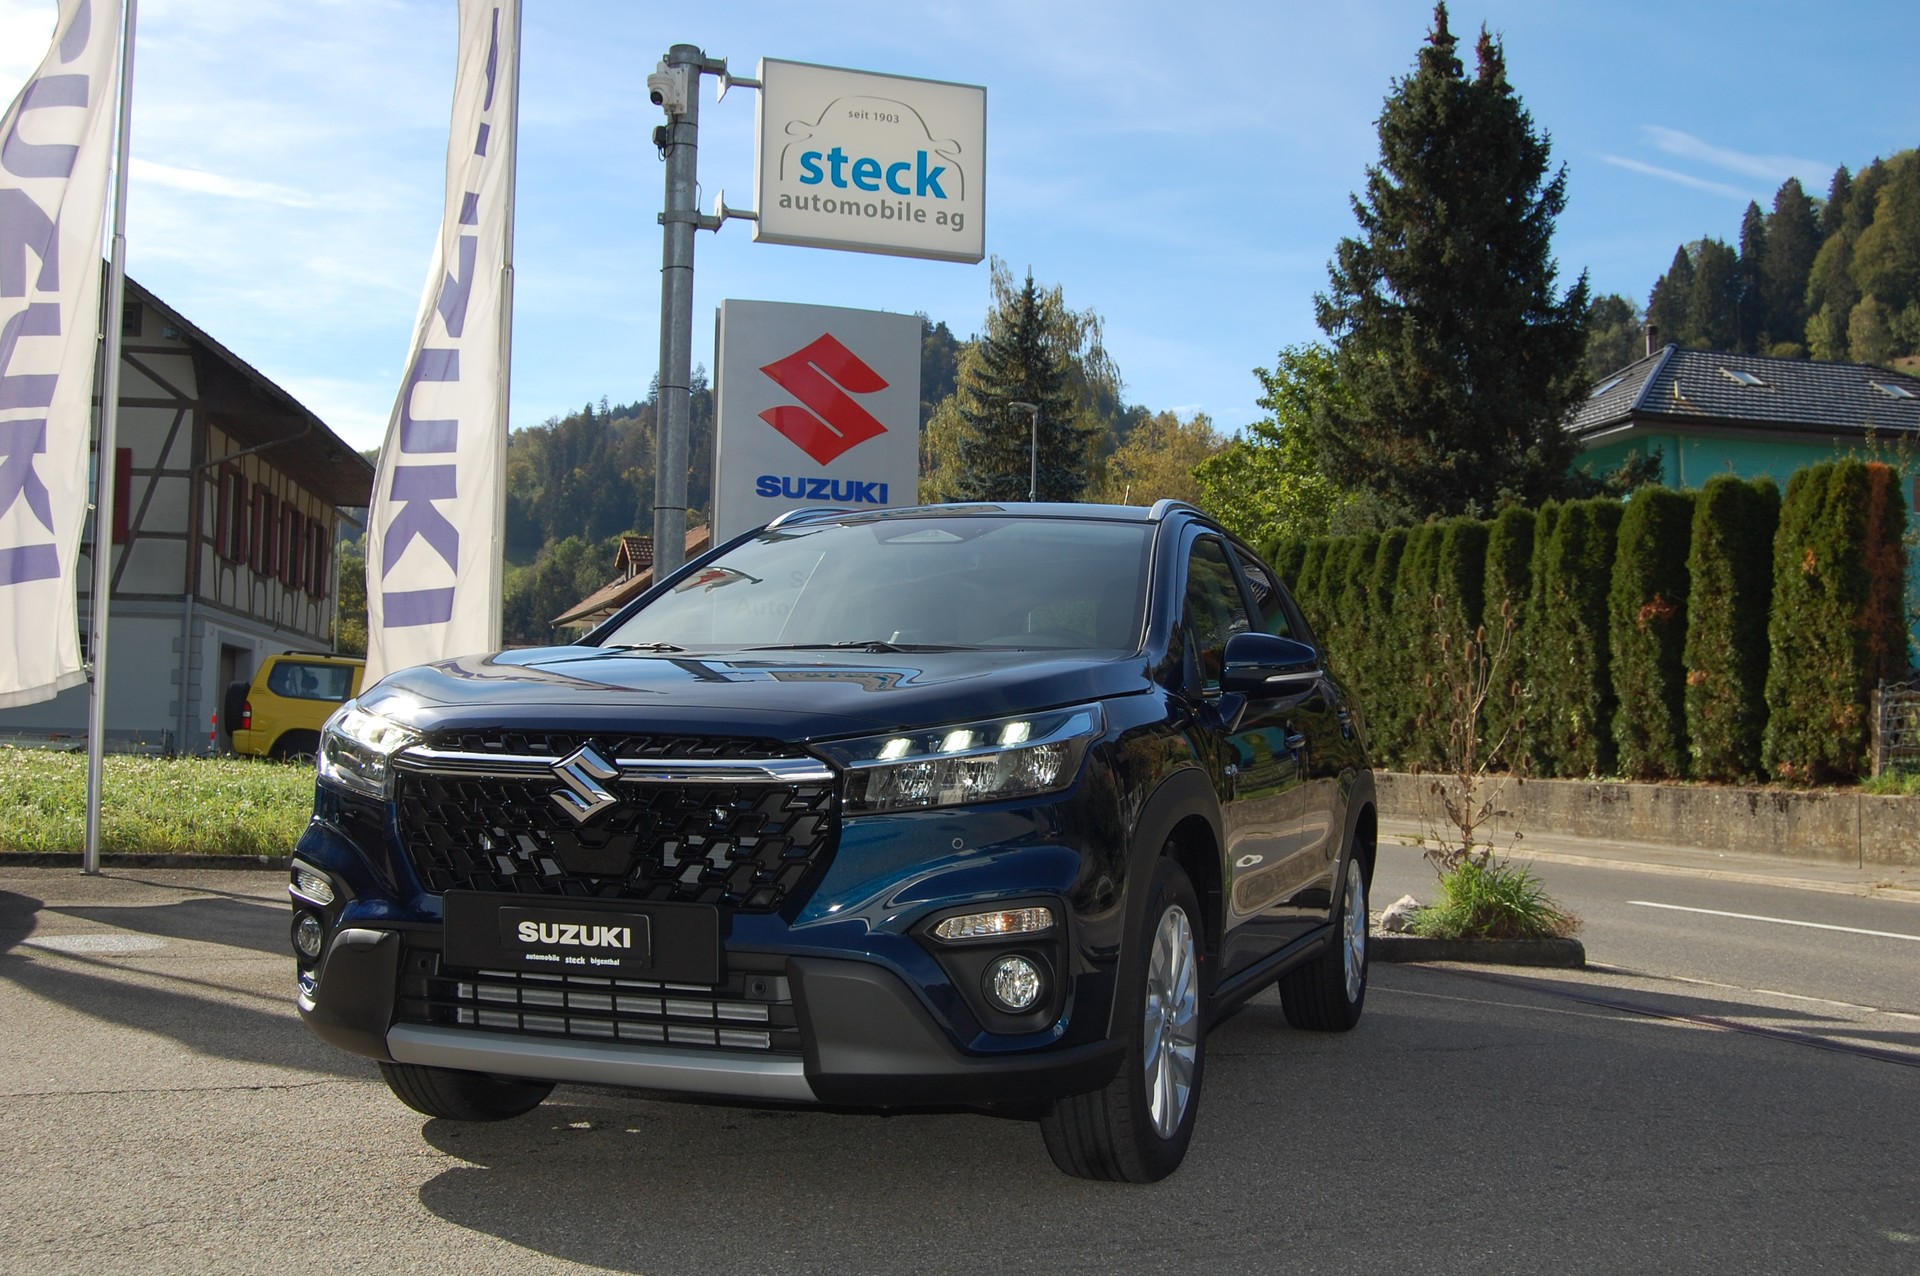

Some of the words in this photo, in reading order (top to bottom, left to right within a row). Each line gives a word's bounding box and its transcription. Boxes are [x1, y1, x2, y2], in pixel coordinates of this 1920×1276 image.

[848, 109, 869, 120] seit
[873, 112, 900, 124] 1903
[799, 146, 948, 200] steck
[778, 193, 927, 223] automobile
[935, 210, 965, 232] ag
[755, 474, 889, 505] SUZUKI
[518, 921, 631, 949] SUZUKI
[525, 953, 560, 963] automobile
[564, 955, 586, 966] steck
[590, 956, 620, 967] bigenthal
